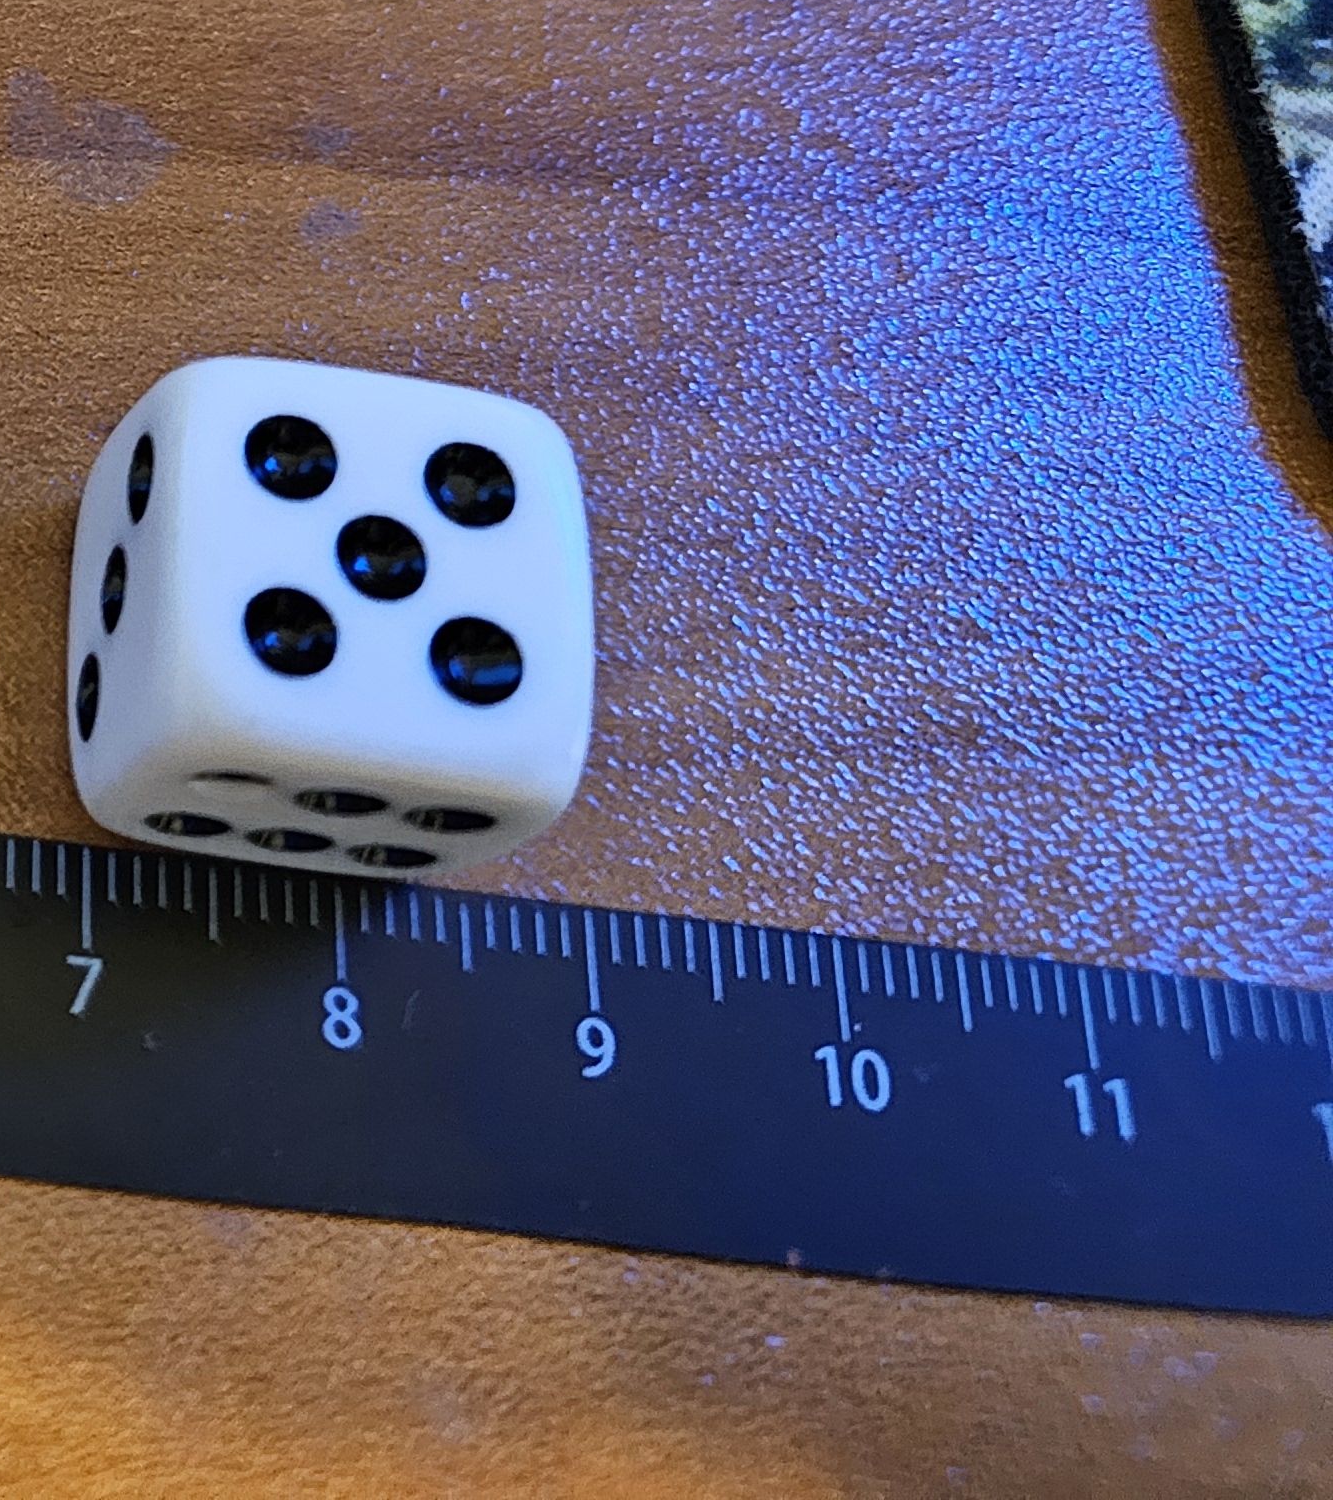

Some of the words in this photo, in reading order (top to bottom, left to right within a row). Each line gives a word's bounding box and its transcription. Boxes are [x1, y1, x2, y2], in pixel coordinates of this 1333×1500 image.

[65, 954, 105, 1018] 7
[321, 986, 363, 1050] 8
[575, 1016, 617, 1080] 9
[813, 1043, 893, 1113] 10
[1062, 1071, 1138, 1143] 11
